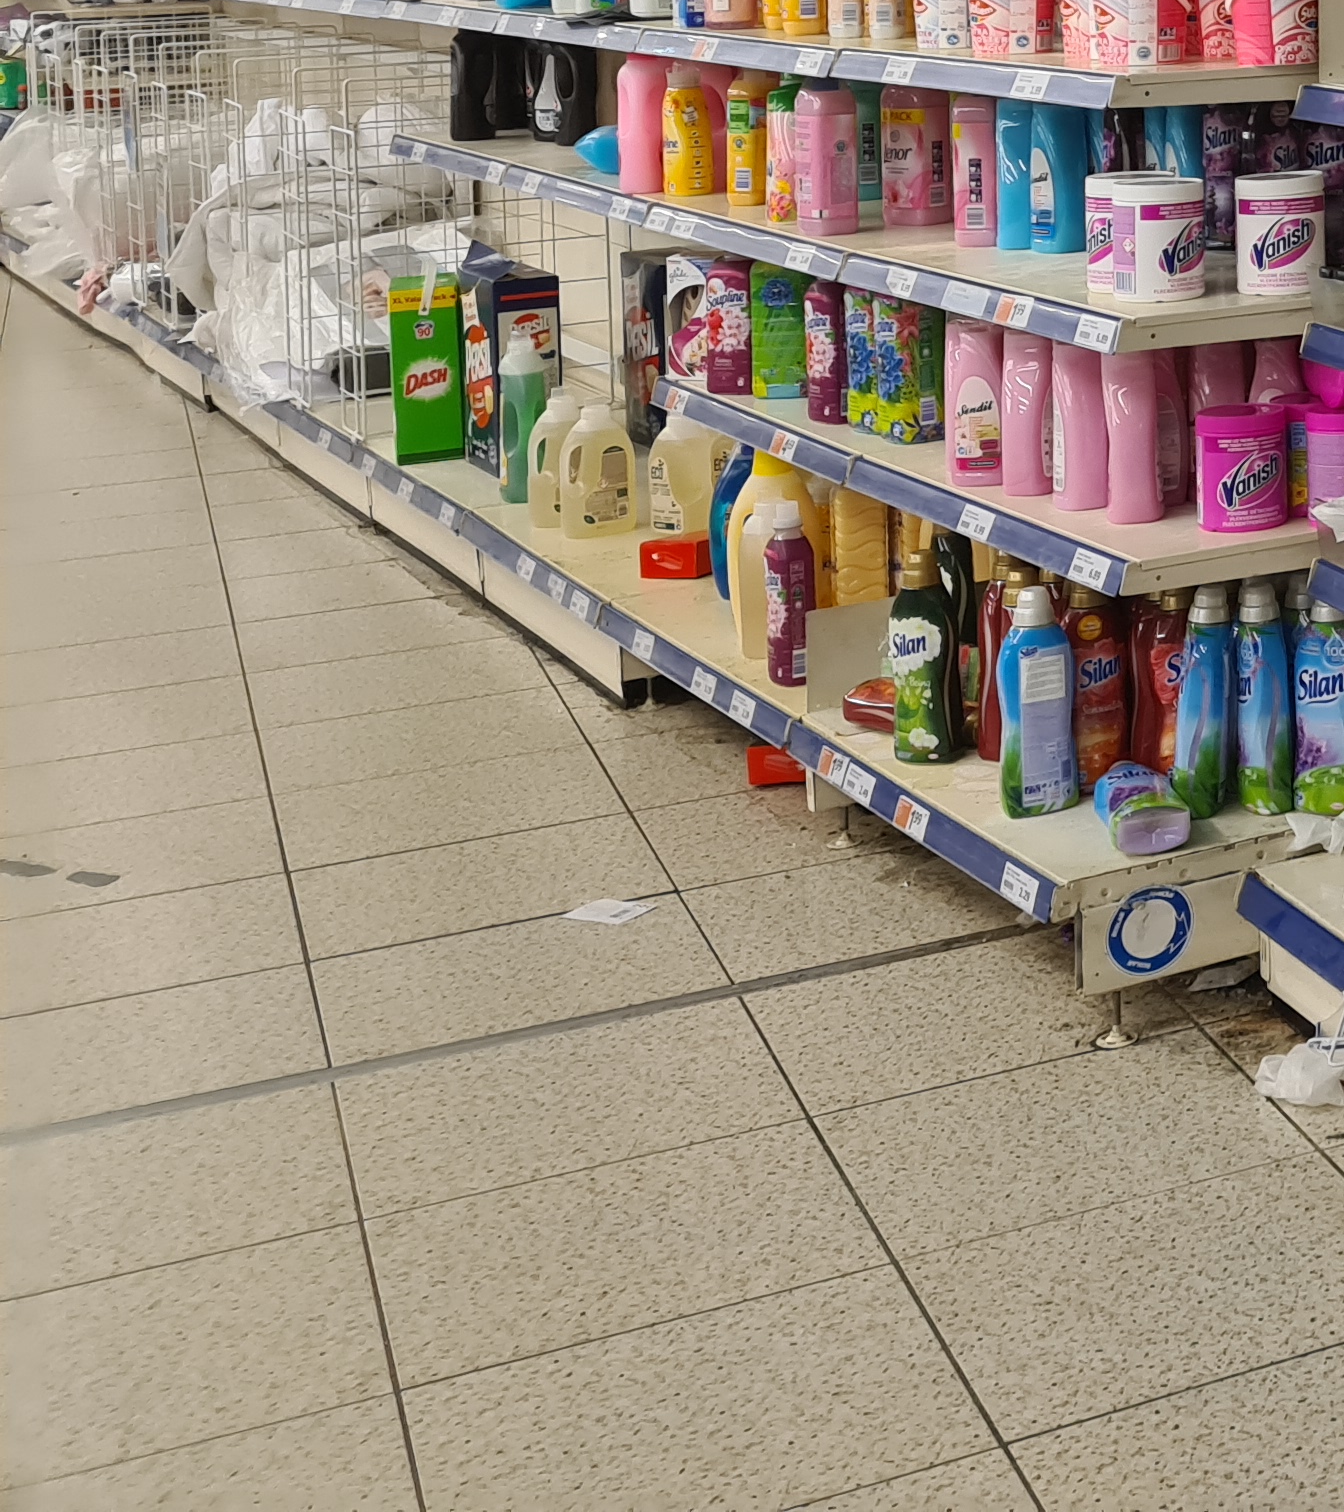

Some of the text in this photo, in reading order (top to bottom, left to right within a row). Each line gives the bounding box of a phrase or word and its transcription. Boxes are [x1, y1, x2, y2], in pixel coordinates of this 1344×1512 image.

[1206, 127, 1238, 152] Silan
[1251, 217, 1310, 272] Vanish
[706, 290, 746, 311] Soupline
[417, 327, 430, 338] 90
[404, 367, 449, 397] DASH
[957, 399, 994, 418] Sendil
[1221, 451, 1278, 508] Vanish
[892, 632, 927, 658] Silan
[1080, 655, 1120, 689] Silan
[1298, 668, 1344, 701] Silan
